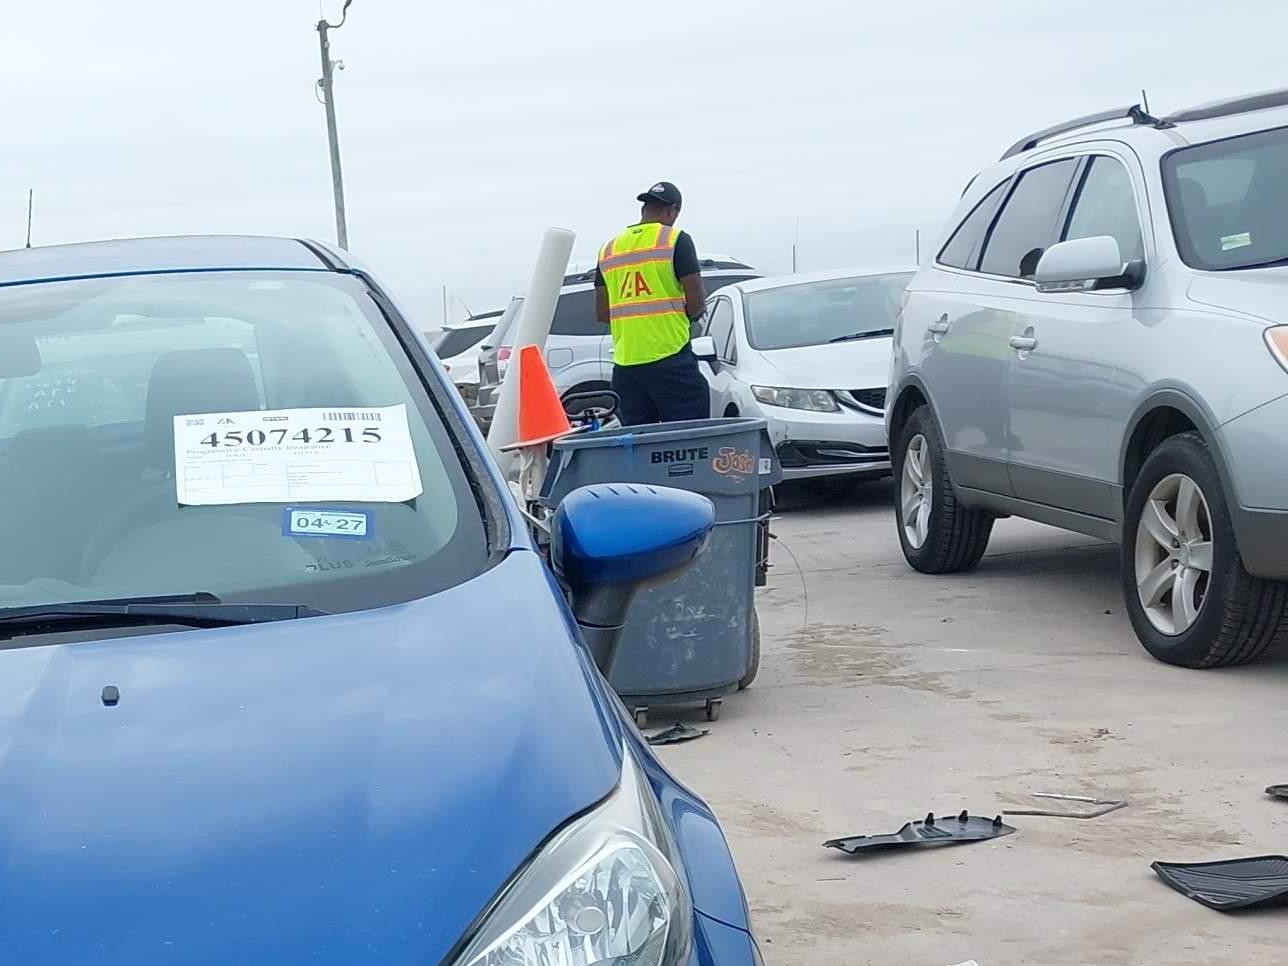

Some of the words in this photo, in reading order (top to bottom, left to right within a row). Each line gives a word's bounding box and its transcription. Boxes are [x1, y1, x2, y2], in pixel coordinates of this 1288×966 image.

[200, 427, 382, 448] 45074215
[651, 447, 708, 464] BRUTE
[297, 517, 323, 528] 04
[336, 519, 364, 530] 27
